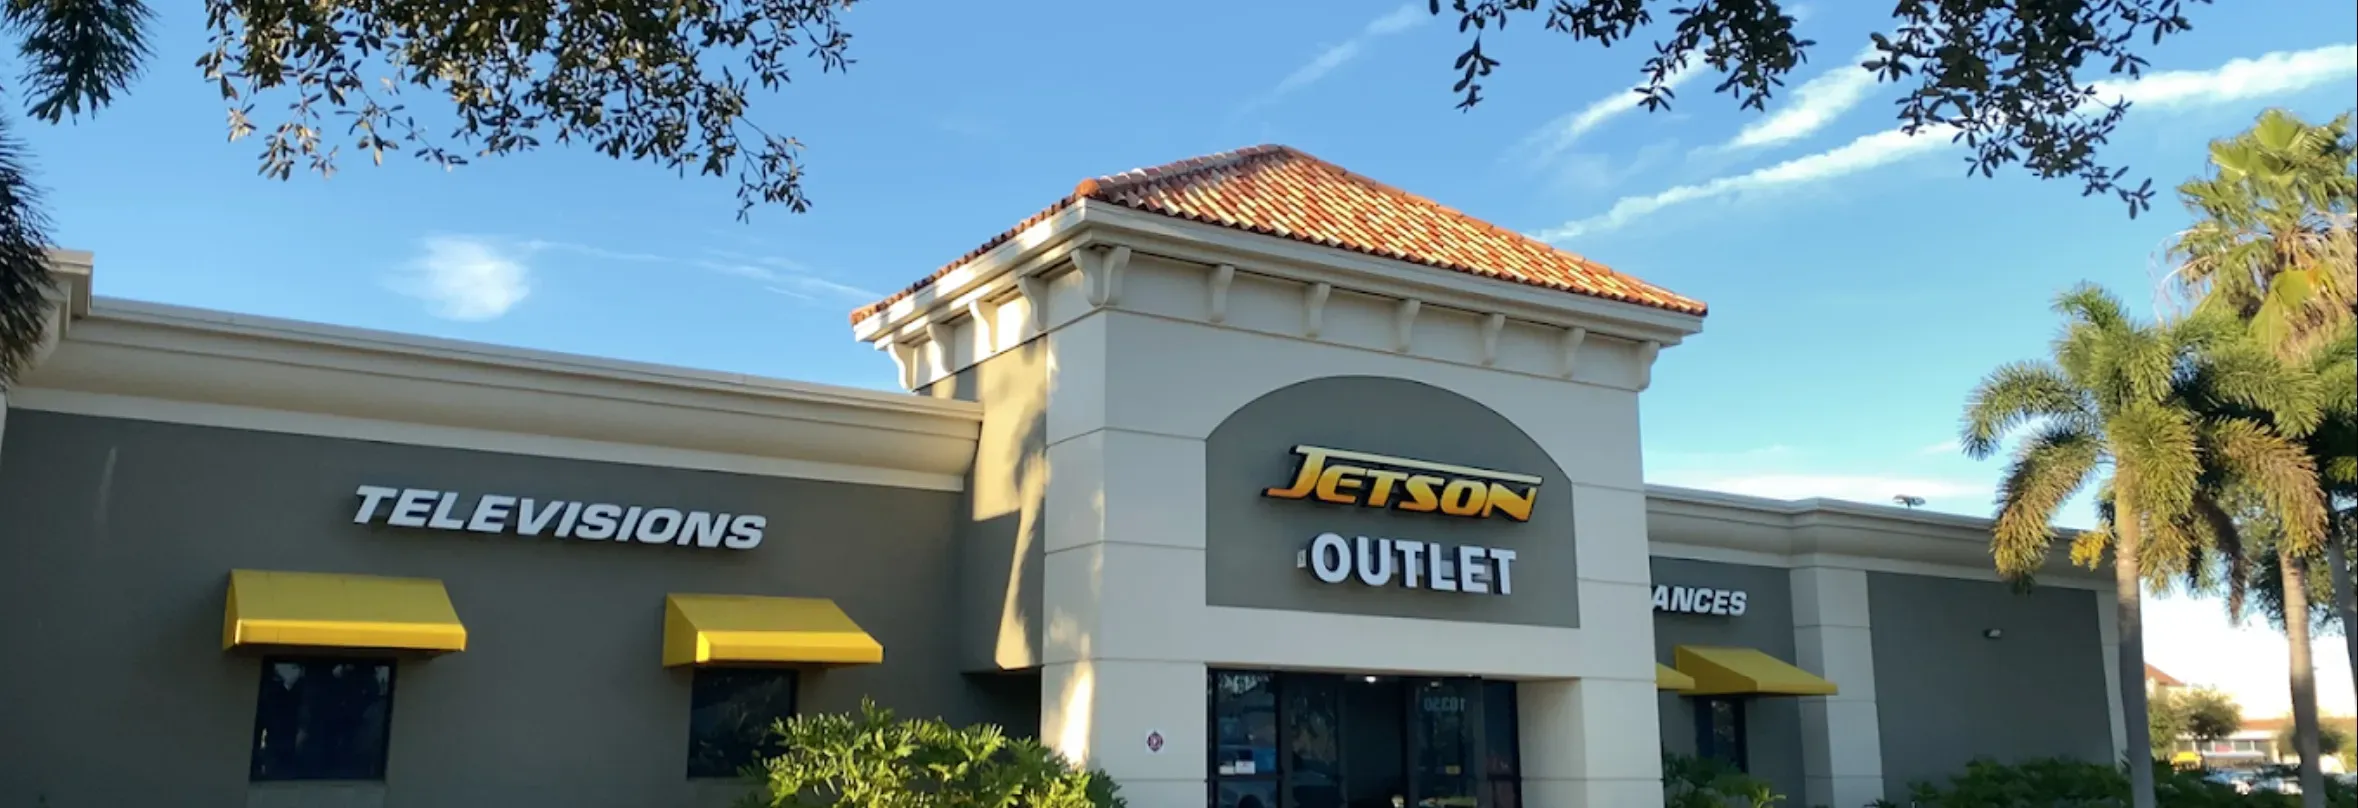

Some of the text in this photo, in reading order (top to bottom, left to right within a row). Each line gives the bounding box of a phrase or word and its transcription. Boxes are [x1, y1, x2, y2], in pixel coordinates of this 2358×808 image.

[1266, 444, 1543, 521] JETSON
[353, 485, 767, 550] TELEVISIONS
[1310, 532, 1517, 595] OUTLET
[1652, 584, 1748, 616] ANCES
